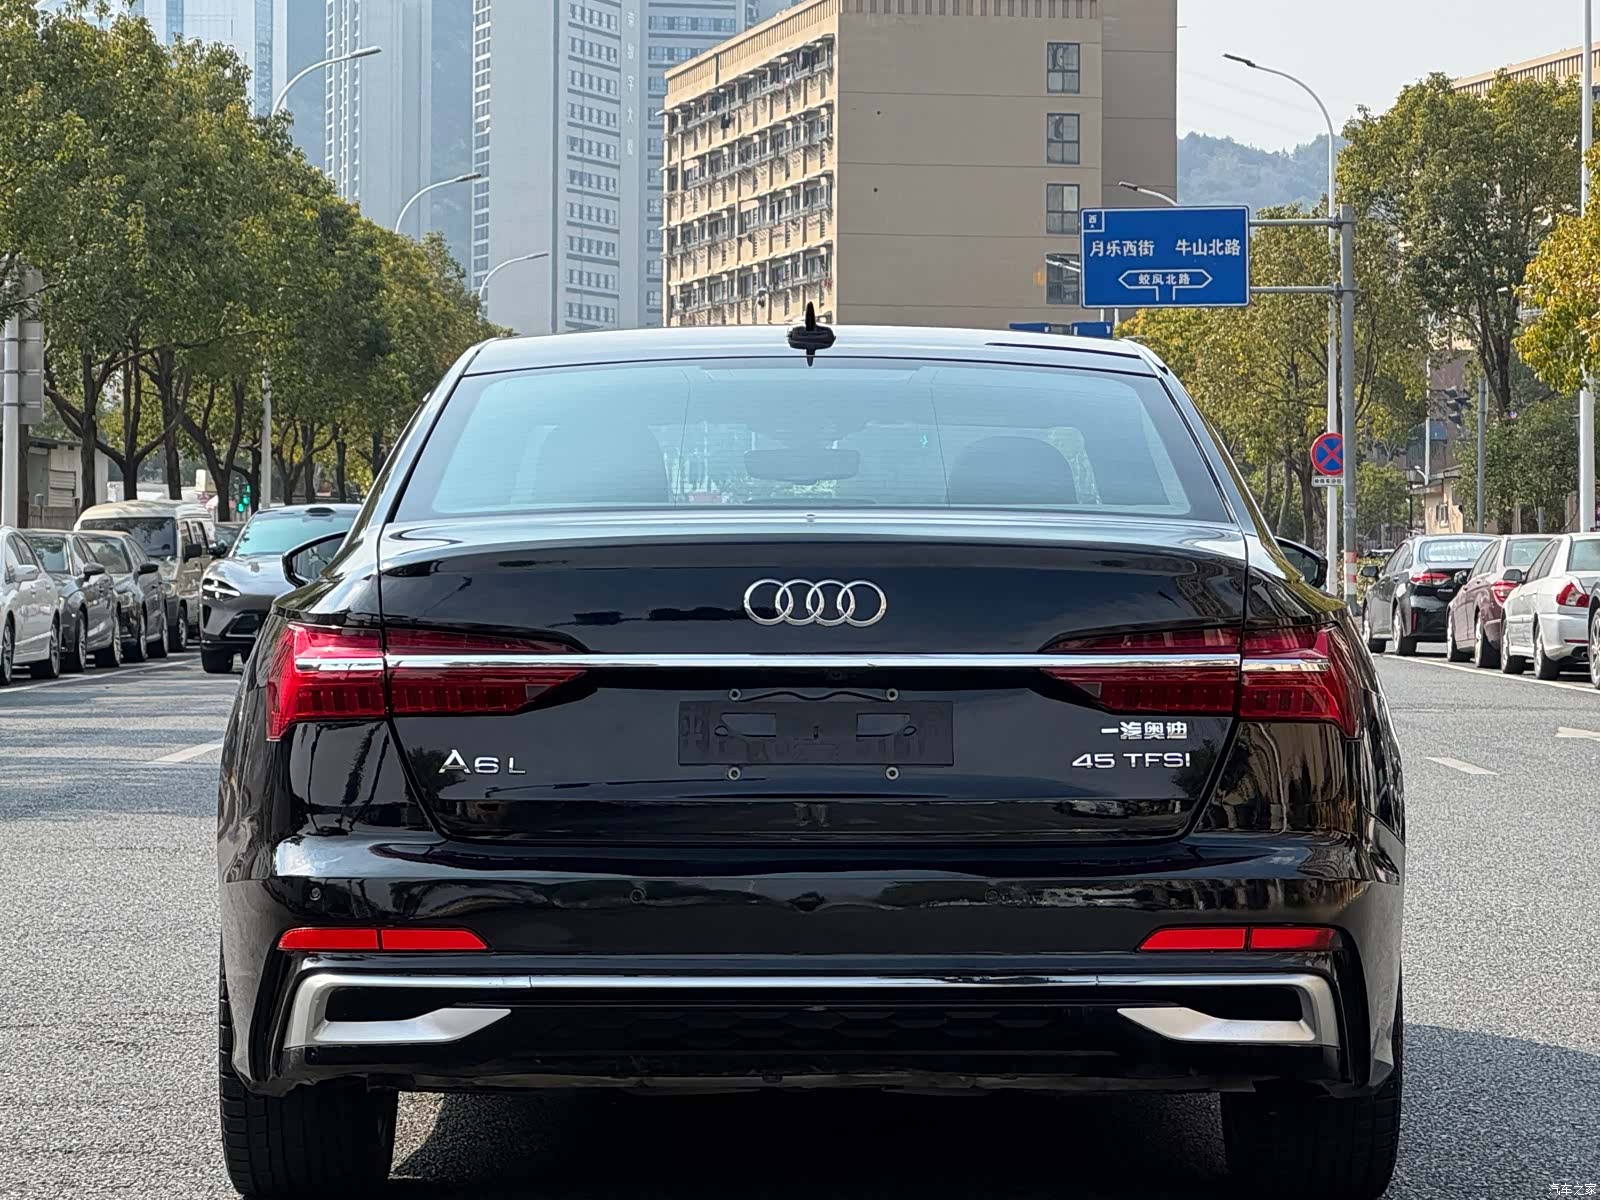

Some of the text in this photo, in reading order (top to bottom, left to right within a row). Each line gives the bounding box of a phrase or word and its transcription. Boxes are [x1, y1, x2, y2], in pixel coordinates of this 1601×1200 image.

[1088, 214, 1097, 224] 西
[1089, 238, 1241, 257] 月乐西街 牛山北路
[1101, 721, 1188, 739] 一汽奥迪
[1072, 752, 1190, 768] 45 TFSI
